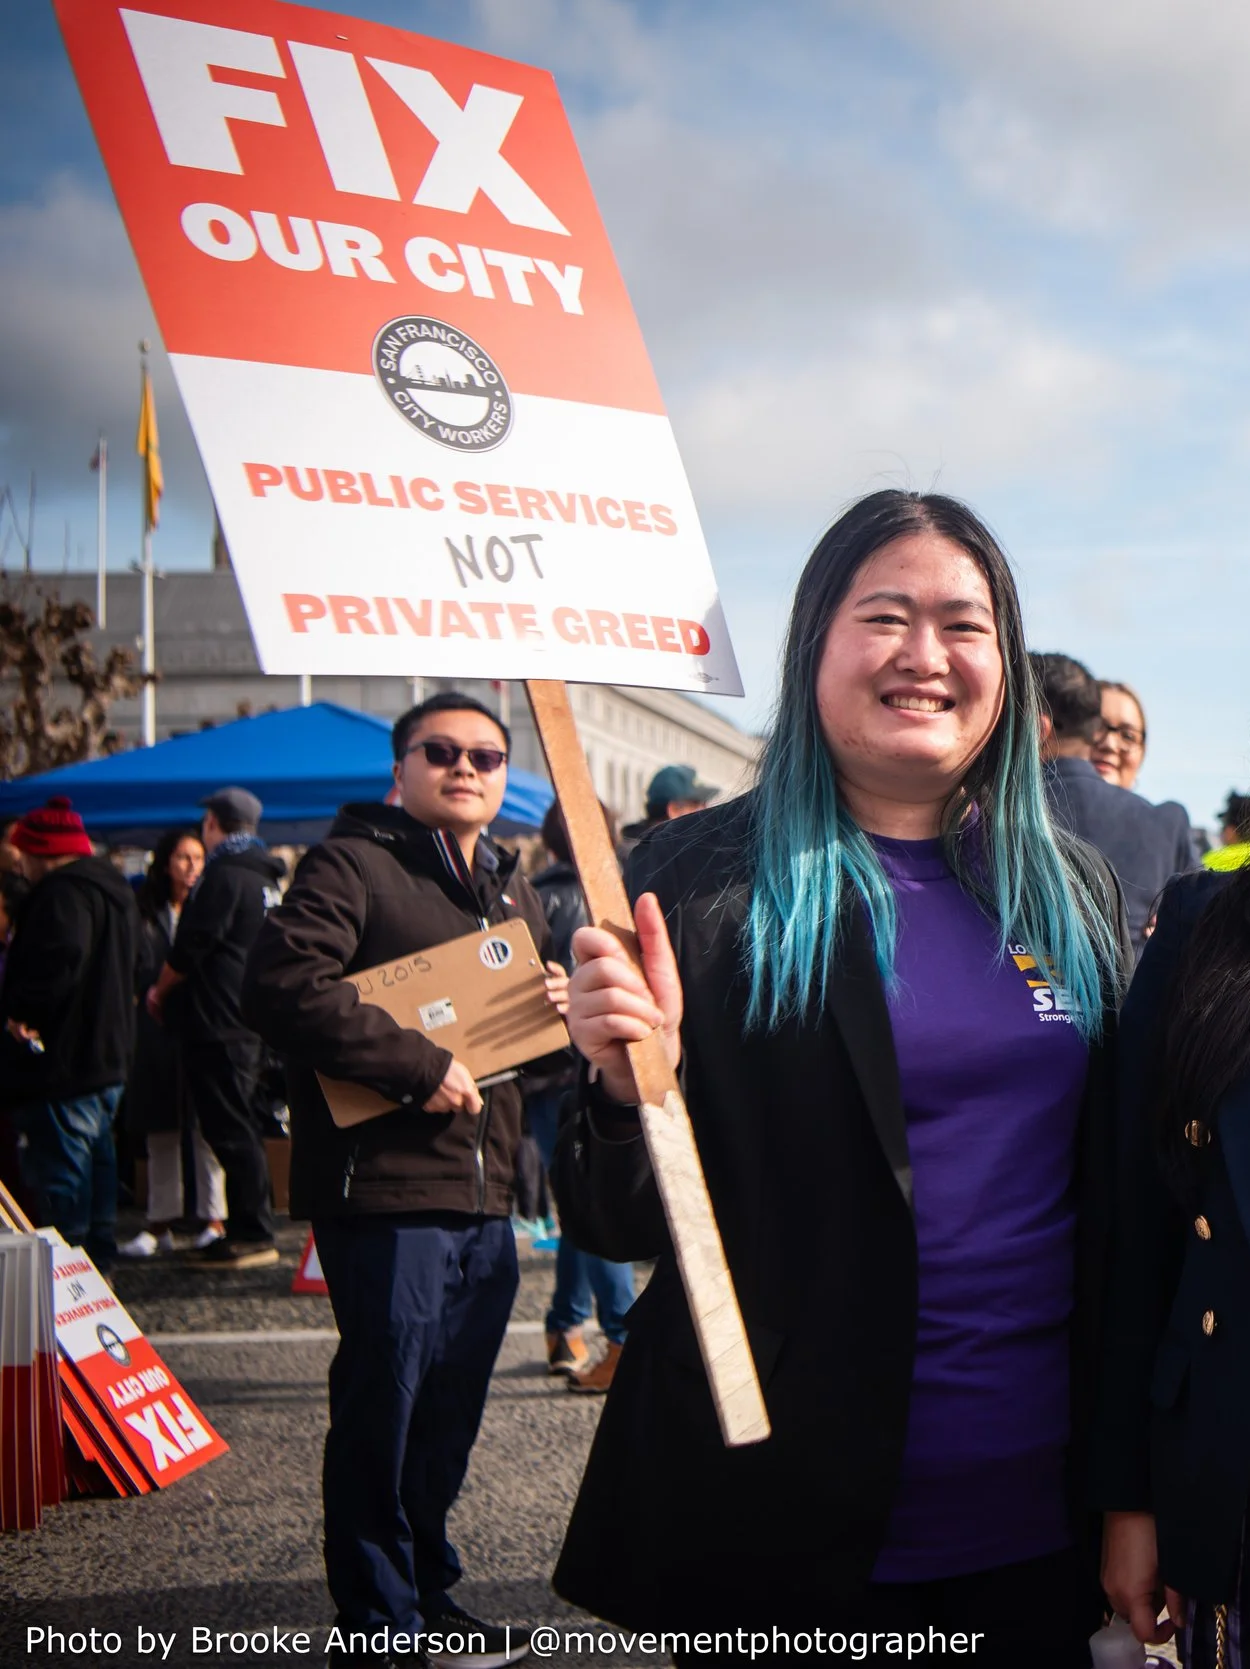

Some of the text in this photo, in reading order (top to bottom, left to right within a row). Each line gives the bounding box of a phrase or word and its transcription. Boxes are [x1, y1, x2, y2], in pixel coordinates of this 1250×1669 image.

[119, 8, 571, 236] FIX
[180, 202, 585, 315] OUR CITY
[380, 324, 499, 384] SAN FRANCISCO
[393, 391, 508, 444] CITY WORKERS
[241, 462, 679, 536] PUBLIC SERVICES
[444, 533, 545, 588] NOT
[281, 593, 711, 657] PRIVATE GREED
[377, 956, 432, 987] 2015
[1033, 988, 1081, 1012] SE
[1038, 1013, 1078, 1024] Strong
[106, 1365, 171, 1409] OUR CITY
[124, 1392, 214, 1472] FIX
